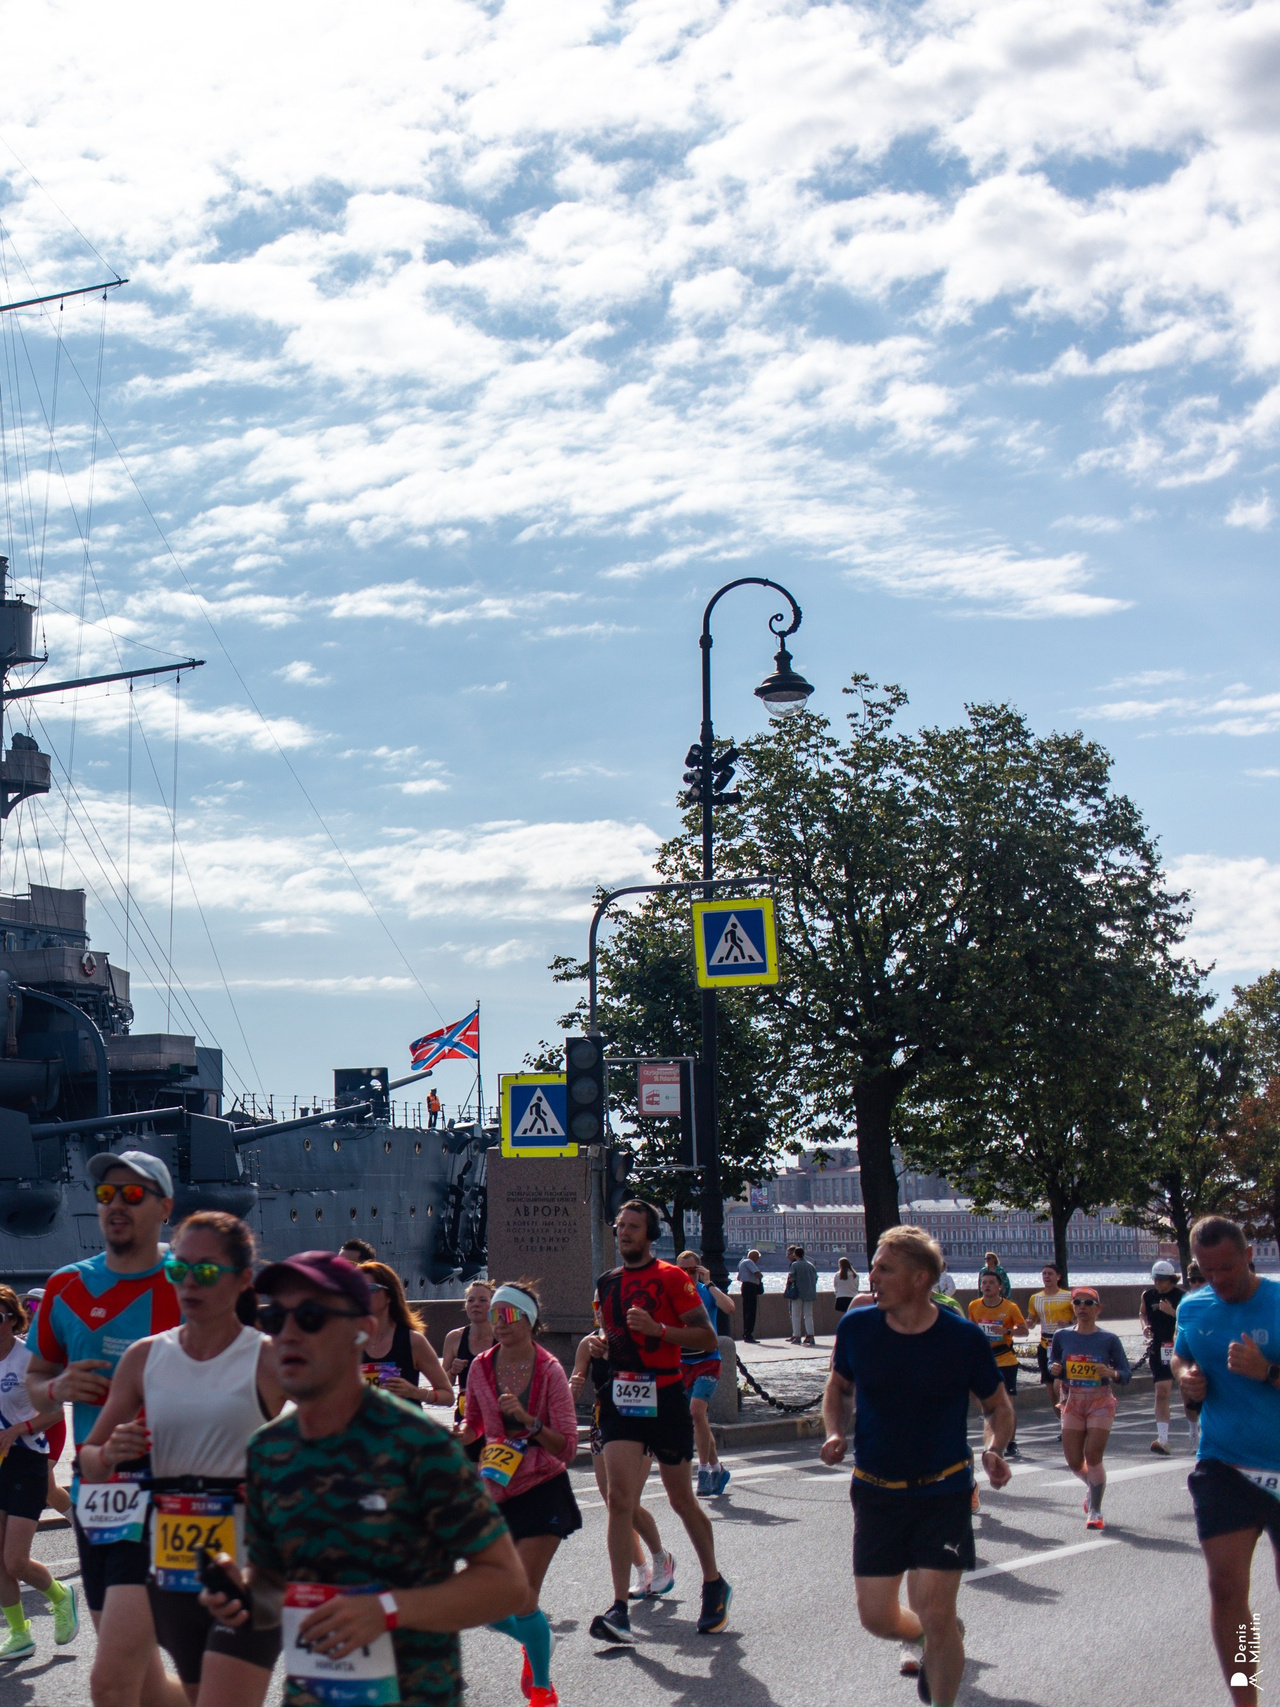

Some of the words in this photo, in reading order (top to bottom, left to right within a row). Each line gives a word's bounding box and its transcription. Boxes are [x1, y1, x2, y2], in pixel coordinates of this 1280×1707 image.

[514, 1205, 569, 1217] АВРОРА
[1070, 1364, 1096, 1375] 6299
[616, 1383, 650, 1398] 3492
[85, 1489, 140, 1513] 4104
[160, 1522, 223, 1552] 1624
